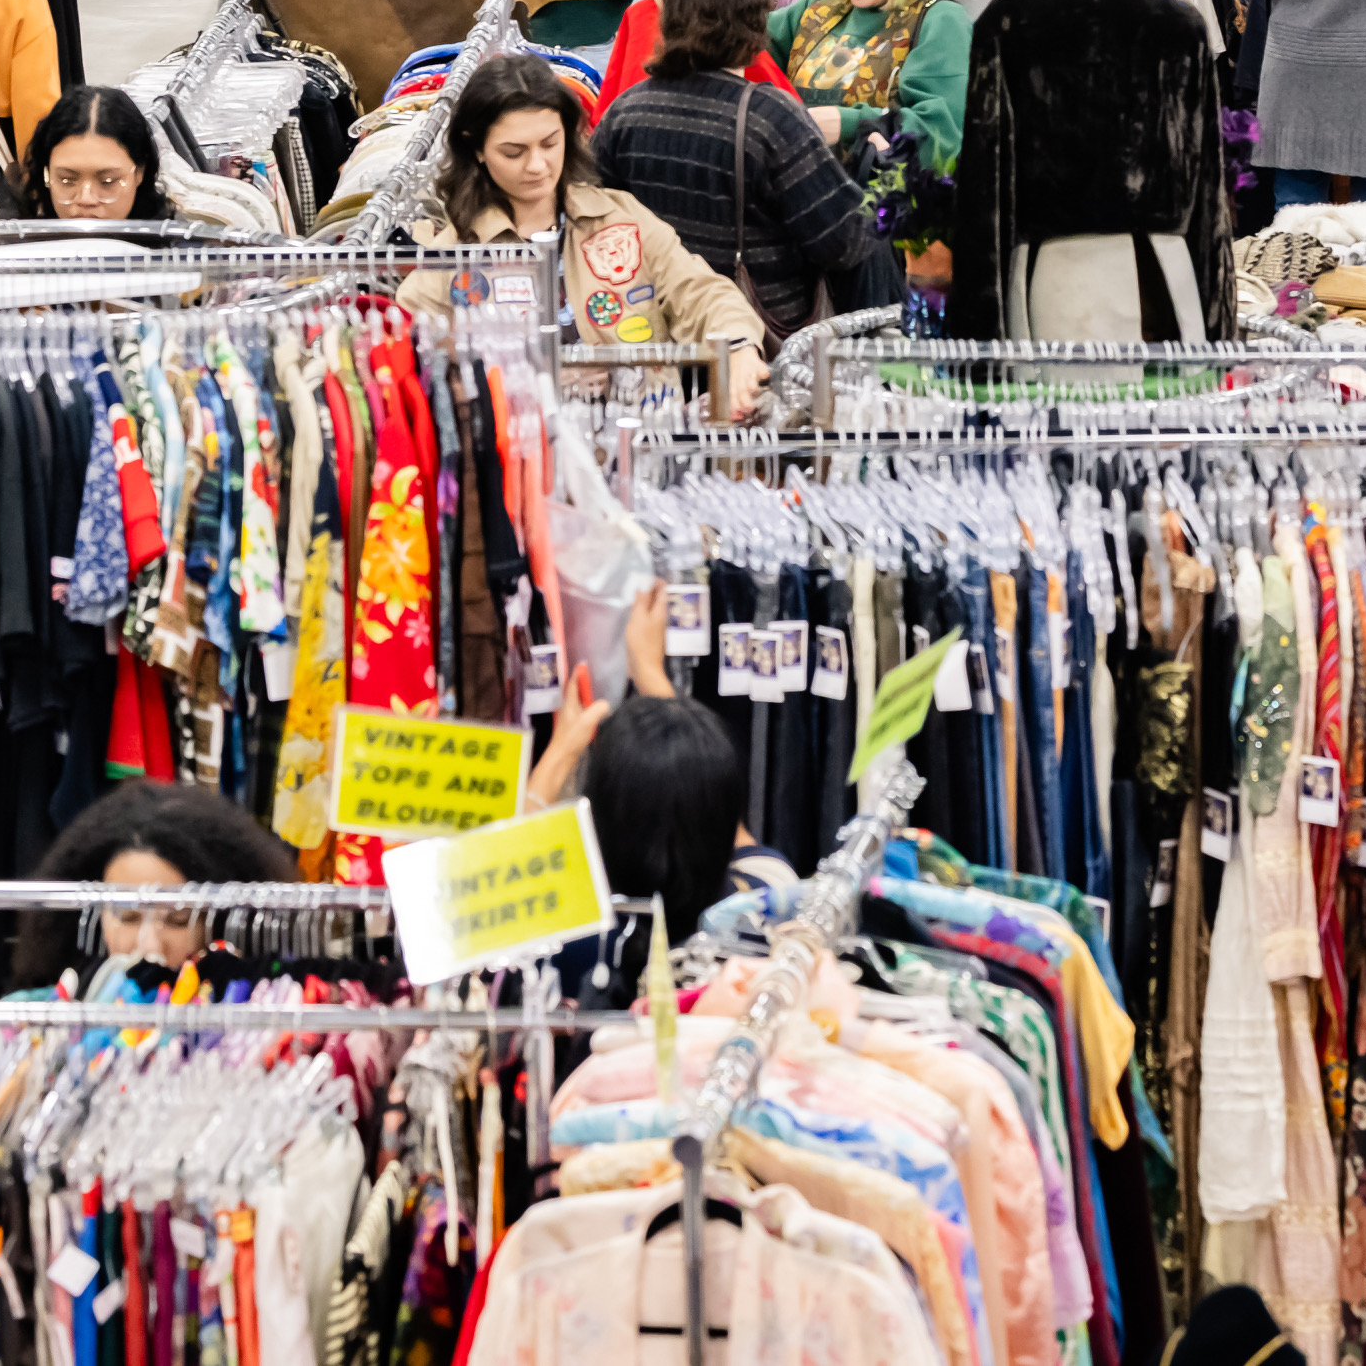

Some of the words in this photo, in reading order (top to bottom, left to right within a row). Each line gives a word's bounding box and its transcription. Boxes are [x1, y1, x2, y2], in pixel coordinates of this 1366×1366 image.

[365, 728, 502, 762] VINTAGE
[352, 761, 432, 789] TOPS
[444, 774, 507, 798] AND
[439, 848, 568, 899] INTAGE
